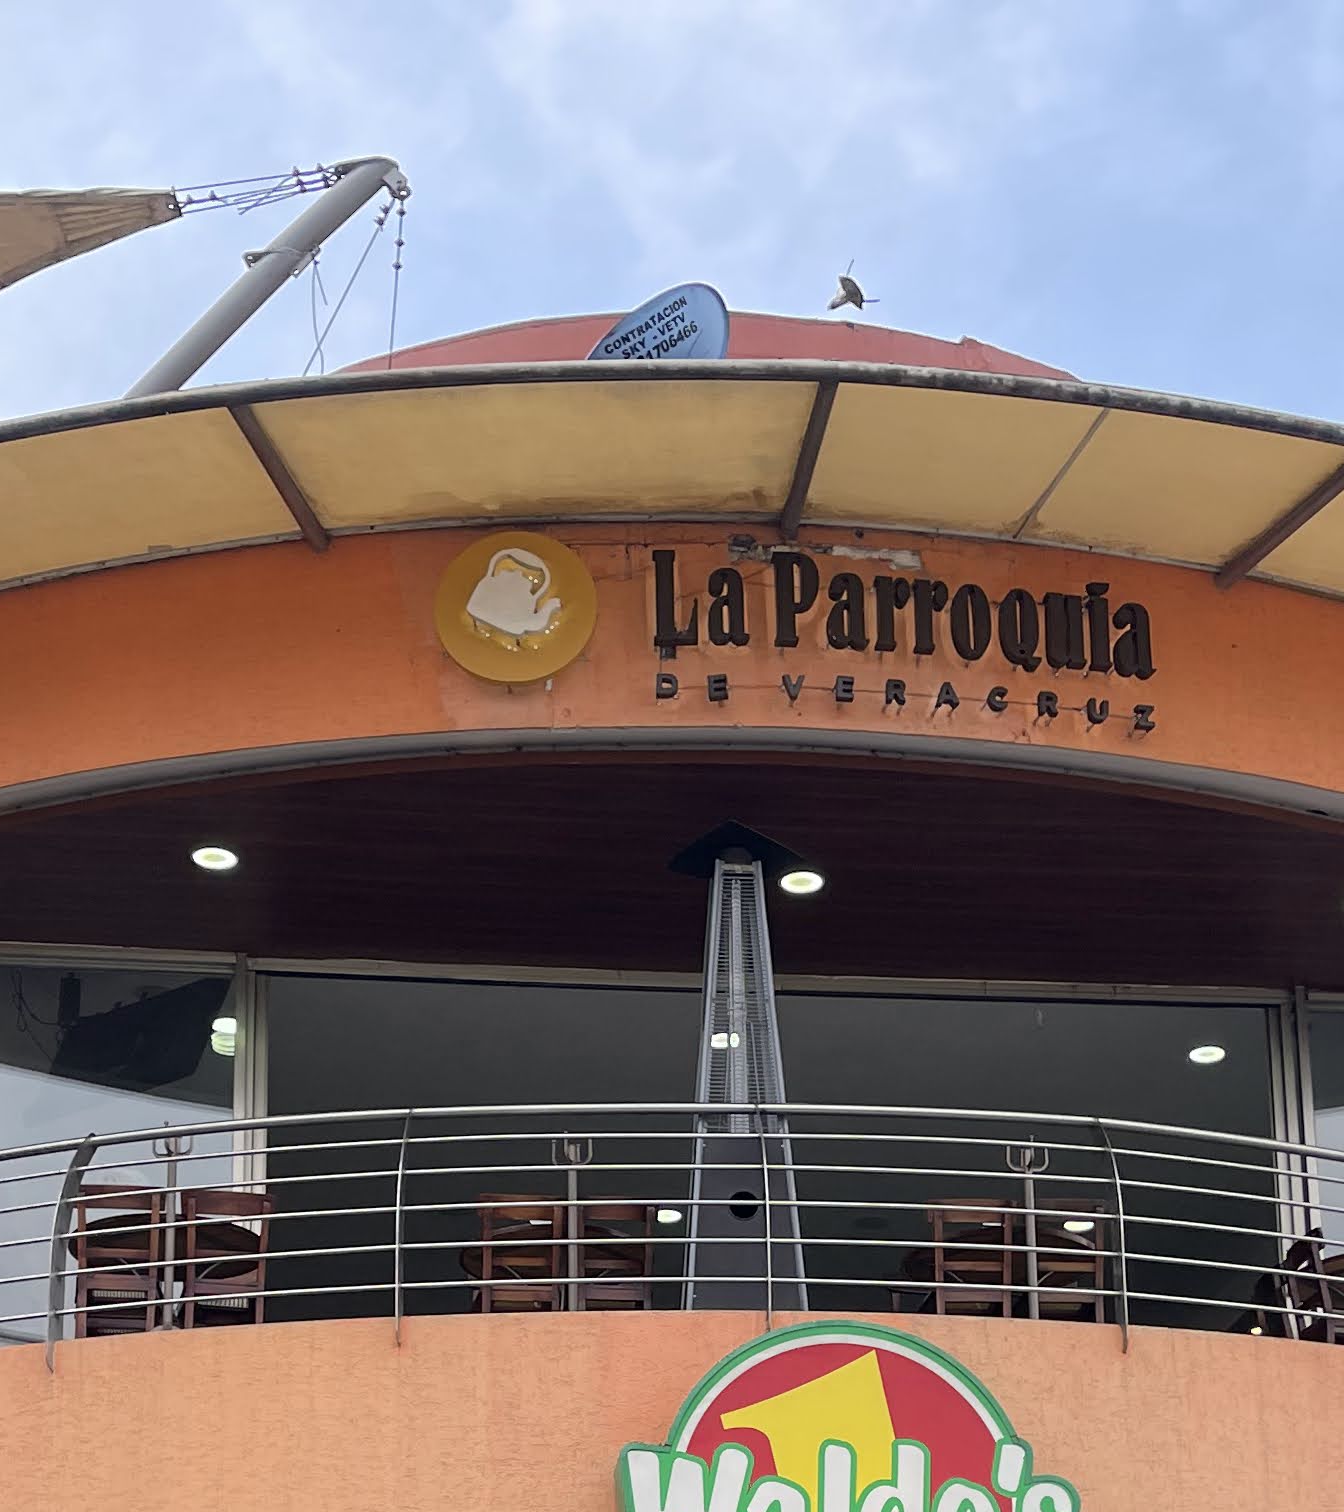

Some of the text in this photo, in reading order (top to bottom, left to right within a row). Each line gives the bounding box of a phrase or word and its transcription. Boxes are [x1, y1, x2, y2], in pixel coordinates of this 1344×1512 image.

[604, 295, 688, 354] CONTRATACION
[622, 337, 646, 359] SKY
[657, 312, 687, 336] VETV
[652, 550, 1156, 680] La Parroquia
[656, 673, 1155, 733] DE VERACRUZ
